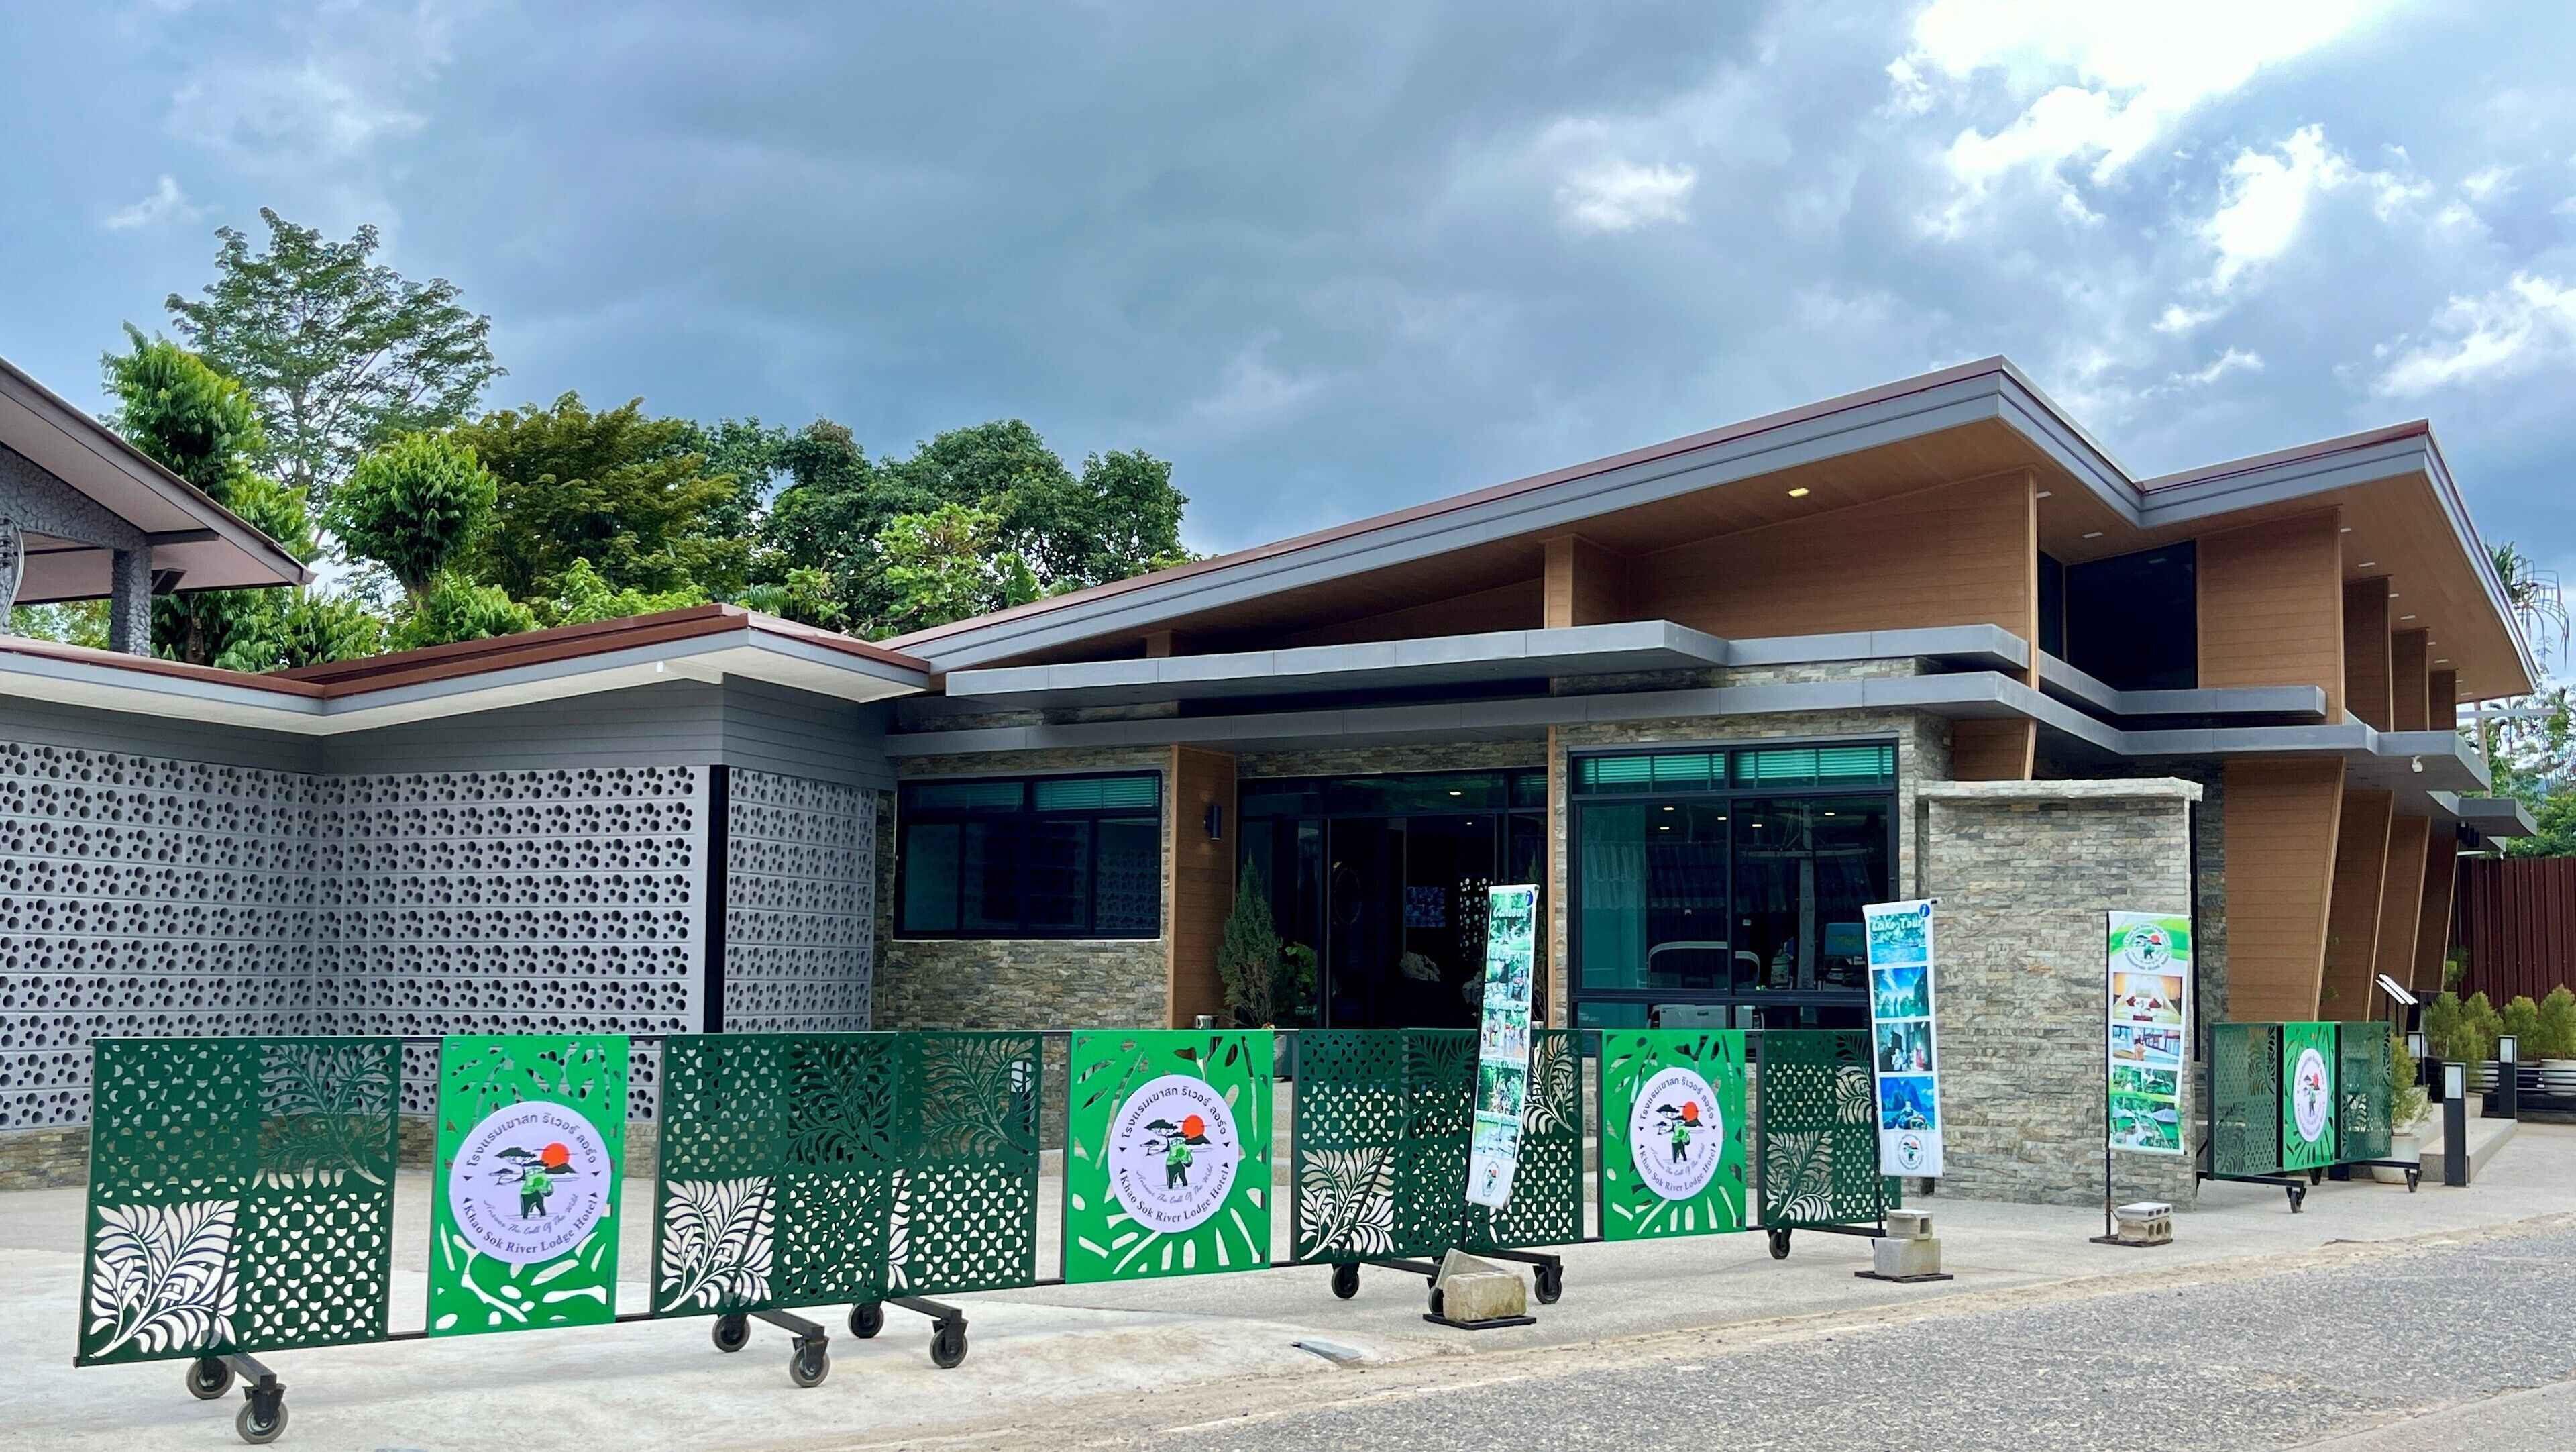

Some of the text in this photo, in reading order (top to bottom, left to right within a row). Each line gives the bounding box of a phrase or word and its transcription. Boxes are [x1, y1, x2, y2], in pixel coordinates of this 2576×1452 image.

[1899, 917, 1923, 929] Tour
[1640, 1149, 1716, 1192] Khao Sok River Lodge Hotel
[1120, 1170, 1230, 1223] Khao Sok River Lodge Hotel
[1156, 1192, 1167, 1203] The
[1185, 1192, 1193, 1203] Of
[1193, 1184, 1203, 1195] The
[464, 1199, 598, 1253] Khao Sok River Lodge Hotel
[508, 1223, 521, 1234] The
[523, 1227, 540, 1235] Call
[543, 1223, 553, 1233] Of
[553, 1215, 566, 1227] The
